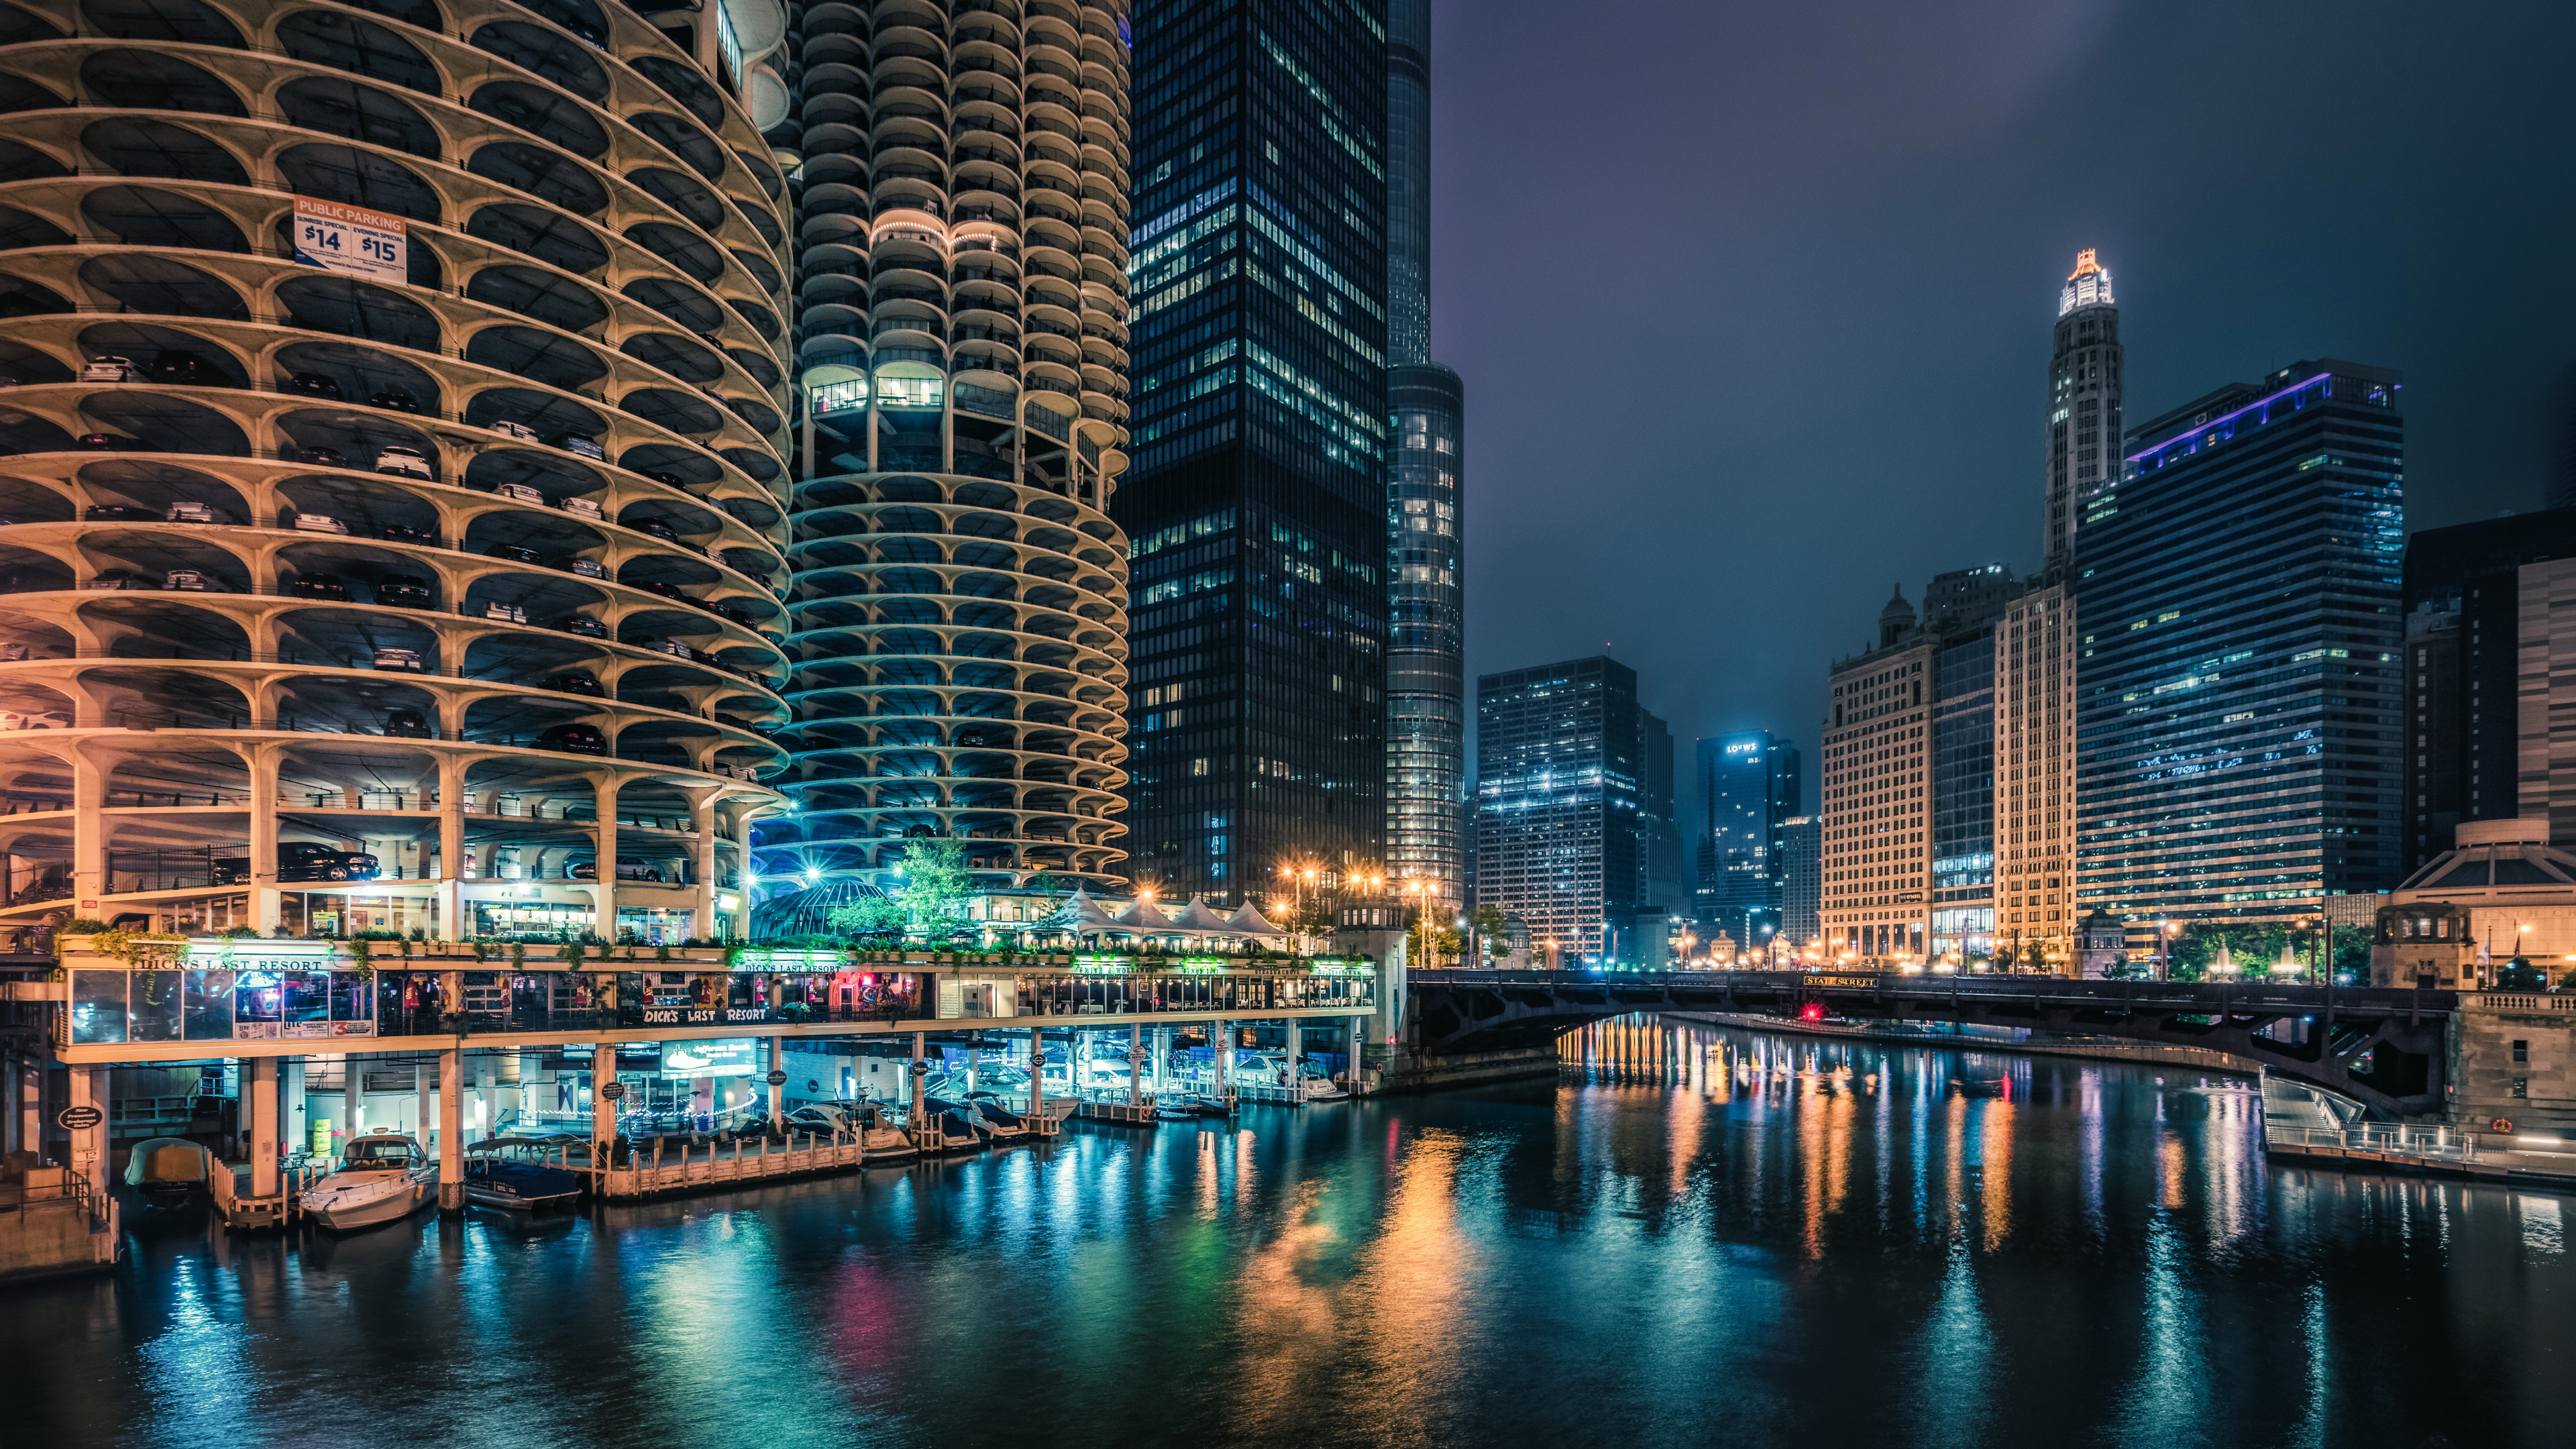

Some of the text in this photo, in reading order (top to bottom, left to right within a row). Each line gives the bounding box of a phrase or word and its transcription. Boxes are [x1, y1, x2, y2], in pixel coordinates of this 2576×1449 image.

[300, 200, 401, 231] PUBLIC PARKING
[297, 216, 347, 231] SUNRISE SPECIAL
[305, 225, 341, 251] $14
[353, 227, 404, 243] EVENING SPECIAL
[362, 237, 396, 262] $15
[325, 260, 345, 268] ENTRANCE
[2210, 376, 2290, 418] WYNDHAM
[142, 959, 322, 971] DICK'S LAST RESORT
[644, 1009, 766, 1022] DICK'S LAST RESORT
[331, 1021, 347, 1036] $3
